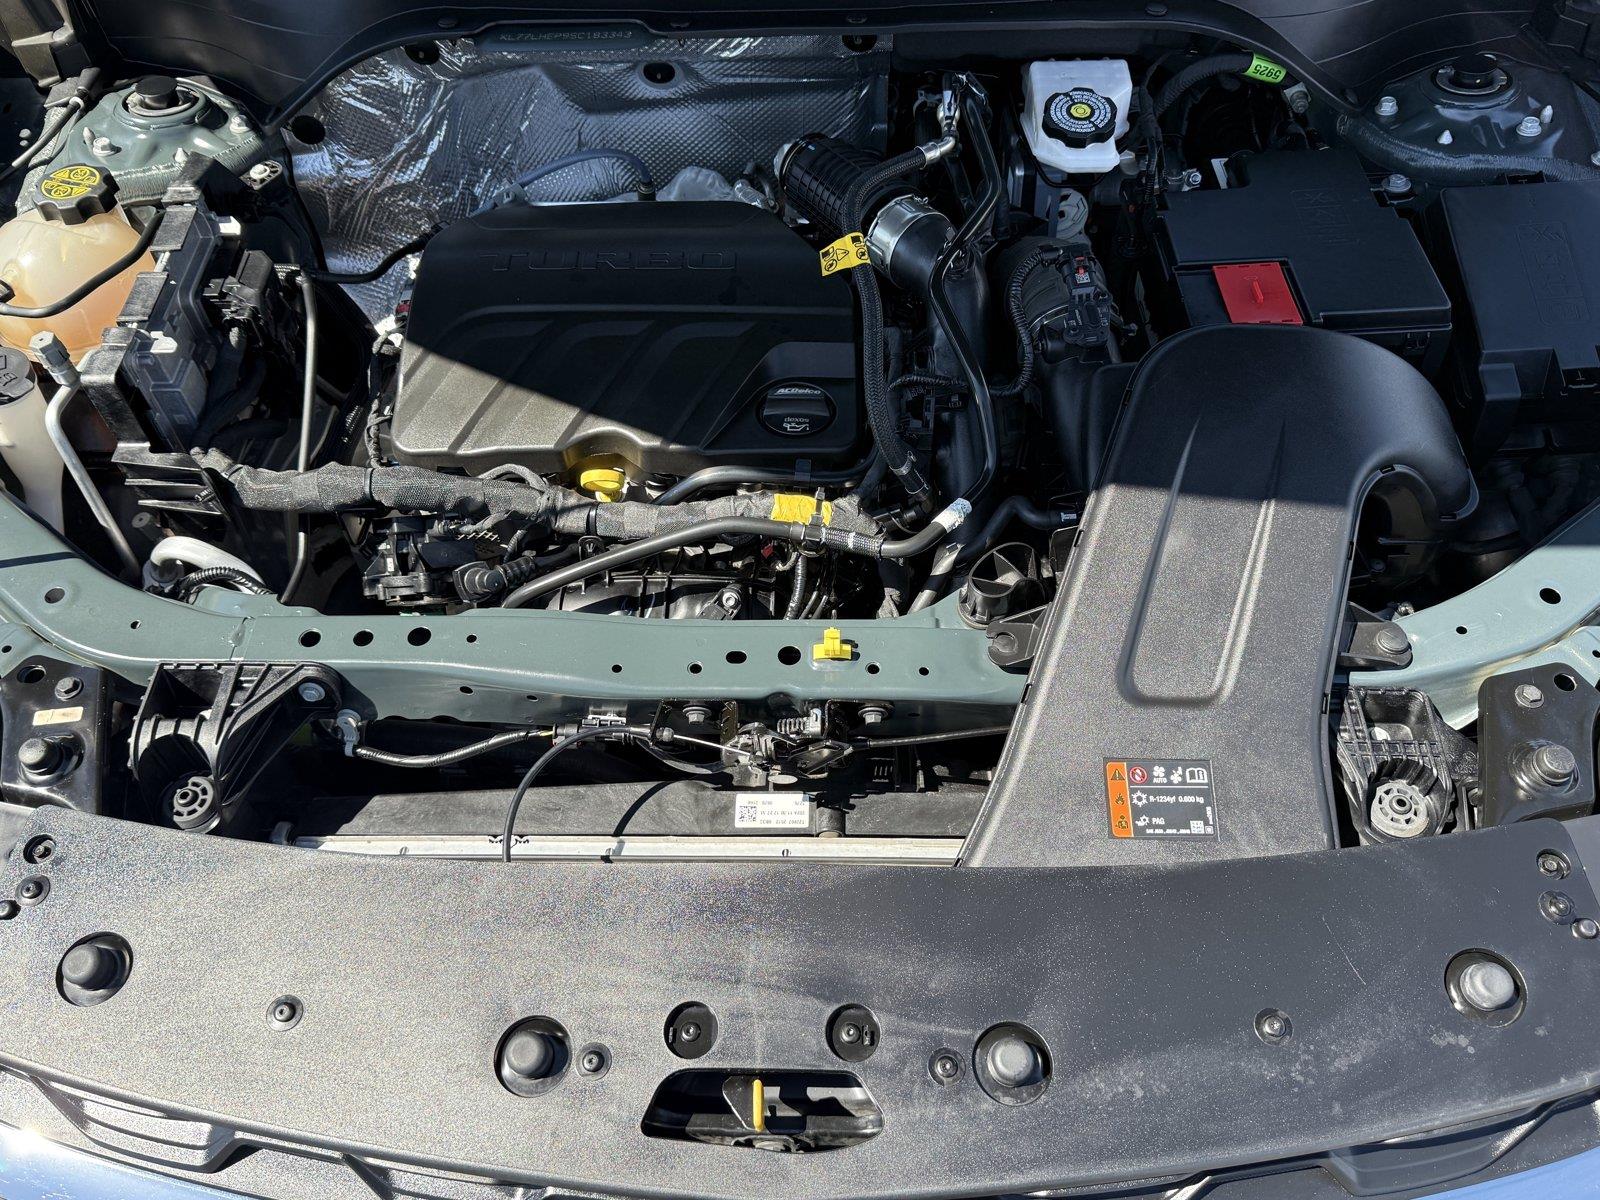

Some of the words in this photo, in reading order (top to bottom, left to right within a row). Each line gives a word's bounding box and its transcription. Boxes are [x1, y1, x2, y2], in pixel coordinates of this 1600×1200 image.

[1252, 64, 1281, 80] 5925
[478, 251, 738, 272] TURBO
[774, 387, 821, 395] ACDelco
